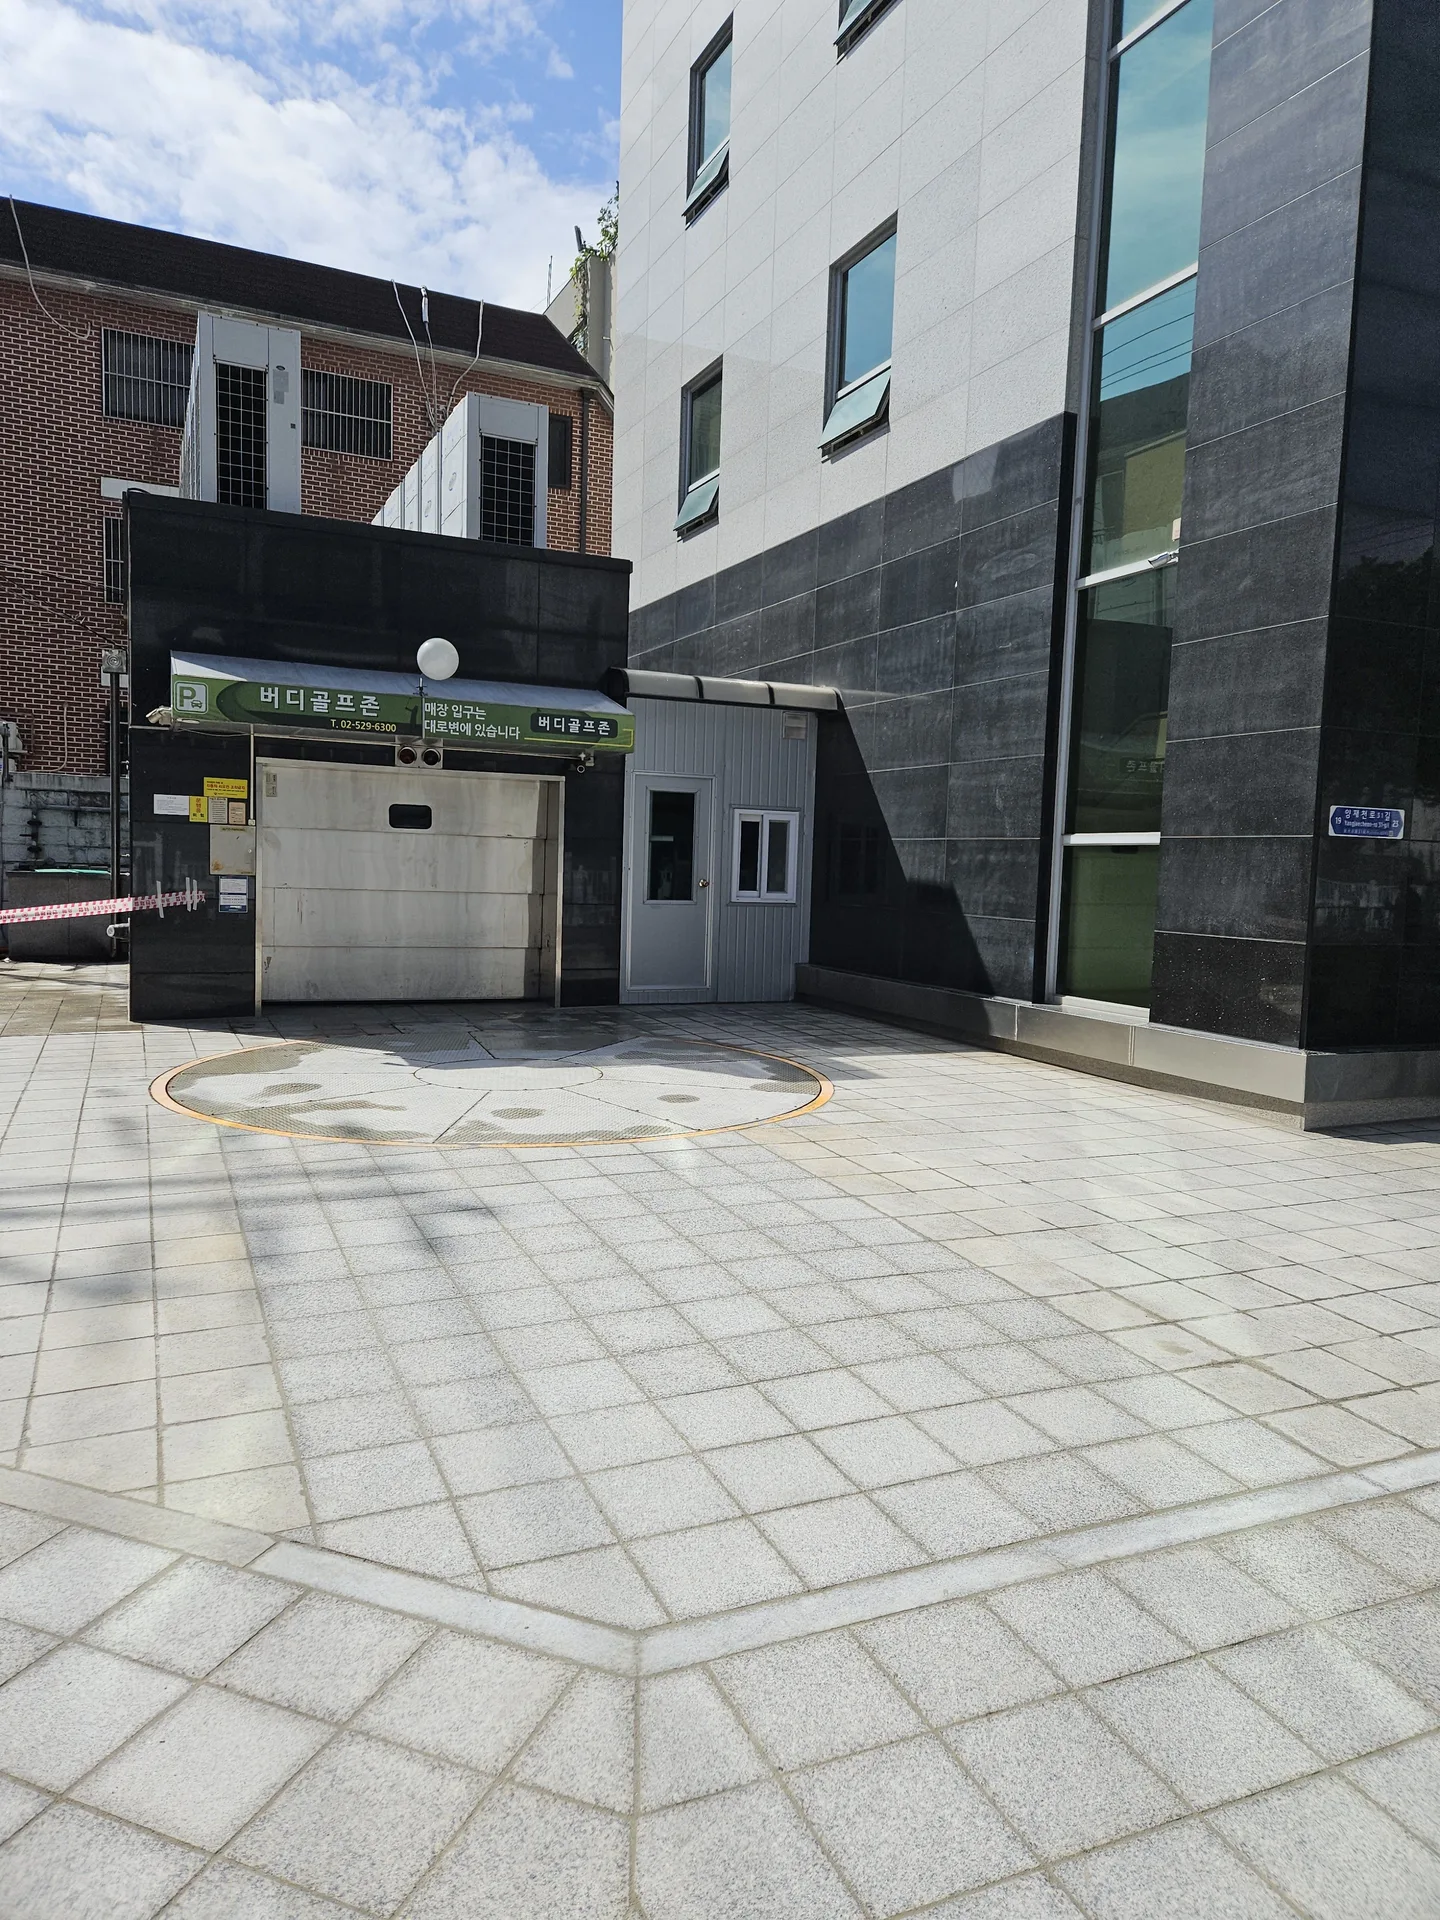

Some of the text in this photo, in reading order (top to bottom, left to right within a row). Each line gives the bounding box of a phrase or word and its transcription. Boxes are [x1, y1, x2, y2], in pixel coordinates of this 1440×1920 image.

[260, 686, 380, 717] 버디골프존
[424, 702, 487, 720] 매장 입구는
[340, 719, 397, 732] 02-529-6300
[424, 719, 520, 740] 대로변에 있습니다
[538, 715, 611, 736] 버디골프존
